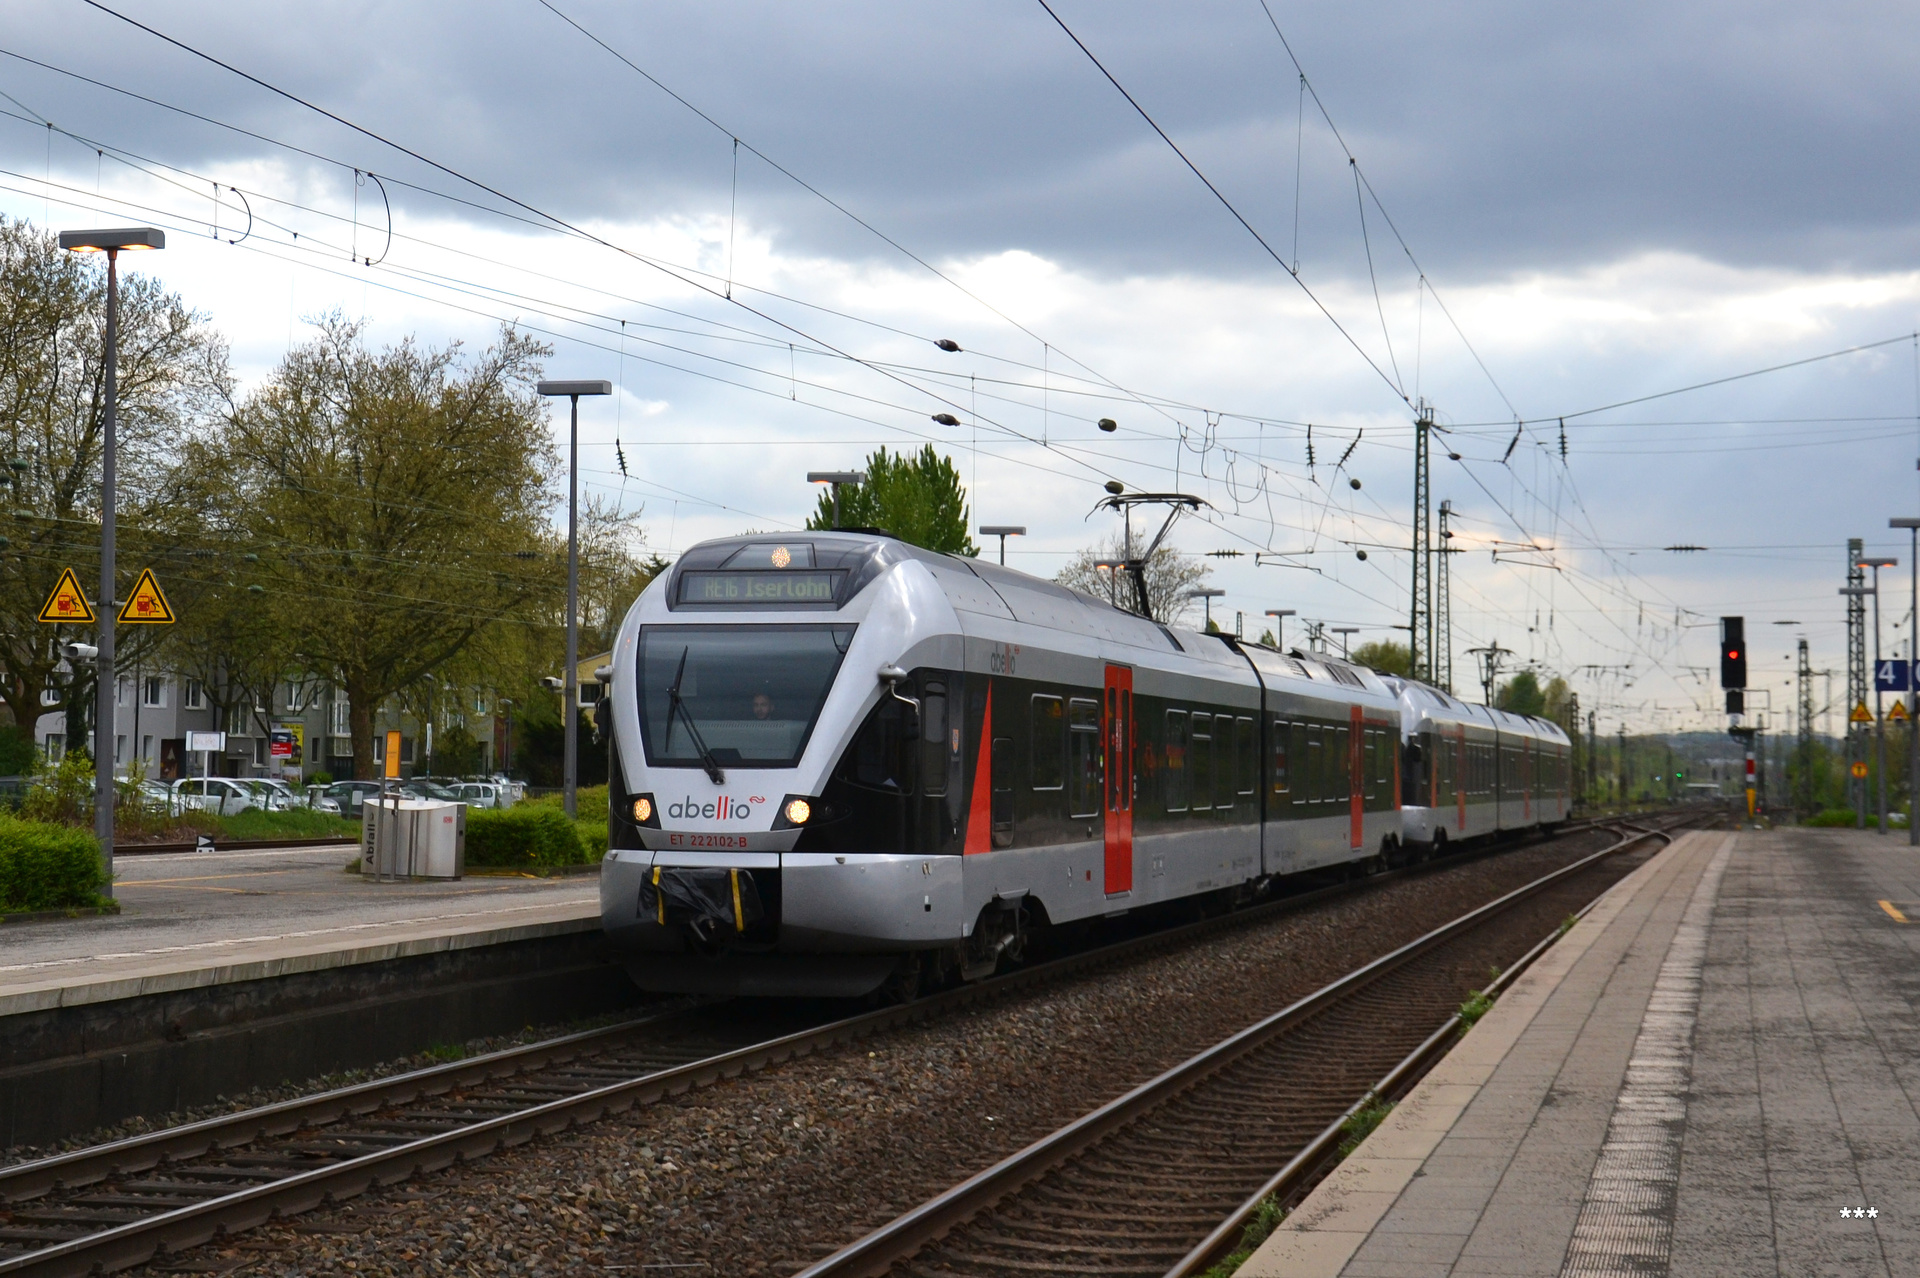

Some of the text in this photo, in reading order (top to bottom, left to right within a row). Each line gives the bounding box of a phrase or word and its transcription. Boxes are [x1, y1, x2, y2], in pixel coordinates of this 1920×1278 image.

[705, 577, 831, 597] RE16 Iserlohn
[1878, 661, 1896, 685] 4
[668, 795, 751, 820] abellio
[366, 824, 375, 864] Abfall
[670, 834, 747, 847] ET 222102-B
